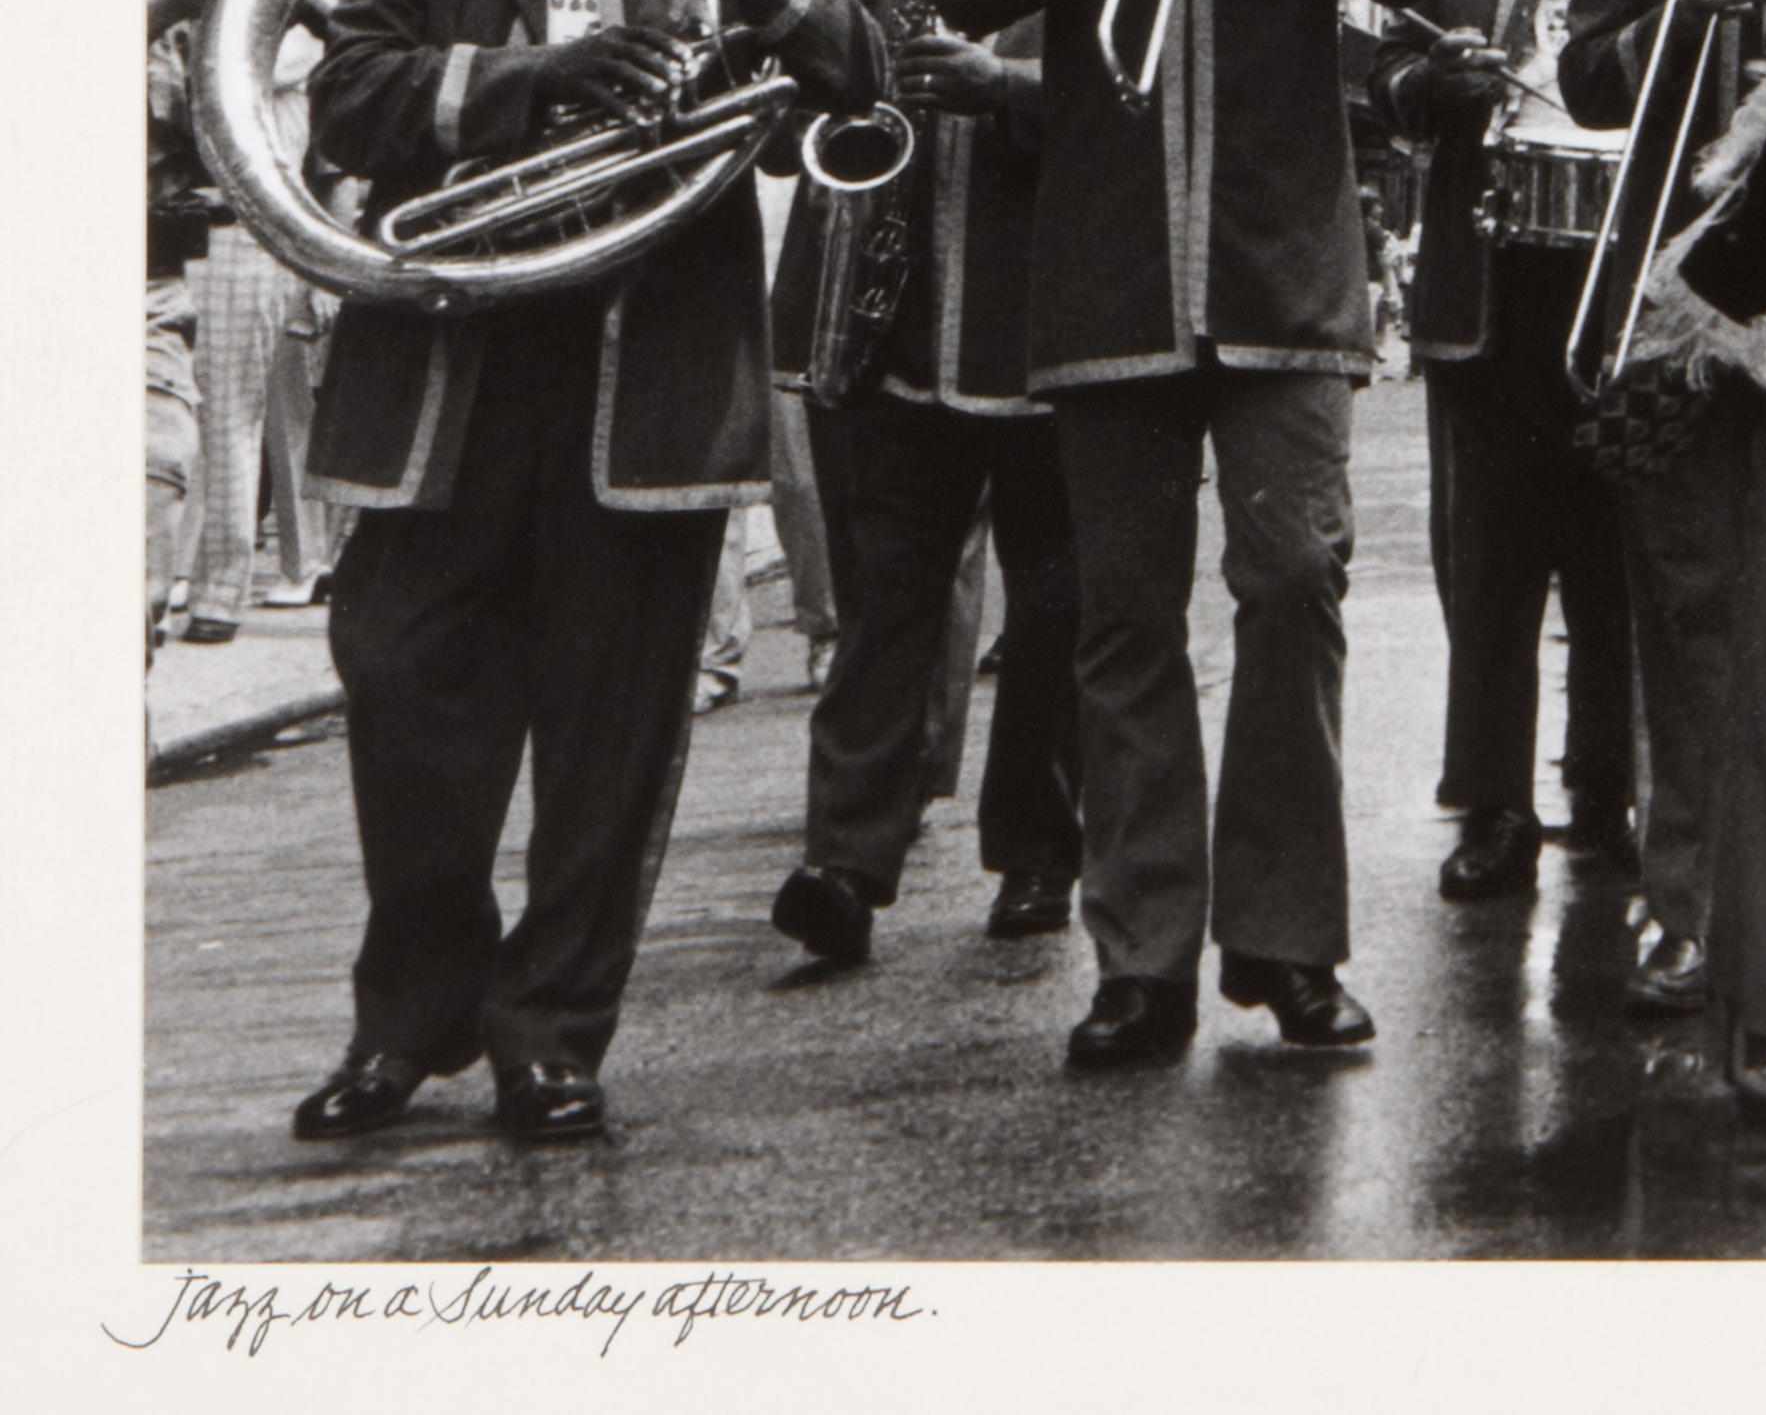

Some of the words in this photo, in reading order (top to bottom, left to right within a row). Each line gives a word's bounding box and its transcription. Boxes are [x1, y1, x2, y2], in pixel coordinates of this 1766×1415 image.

[290, 1281, 375, 1326] on
[383, 1285, 423, 1318] a
[428, 1266, 646, 1358] Sunday
[652, 1272, 940, 1348] afternoon.
